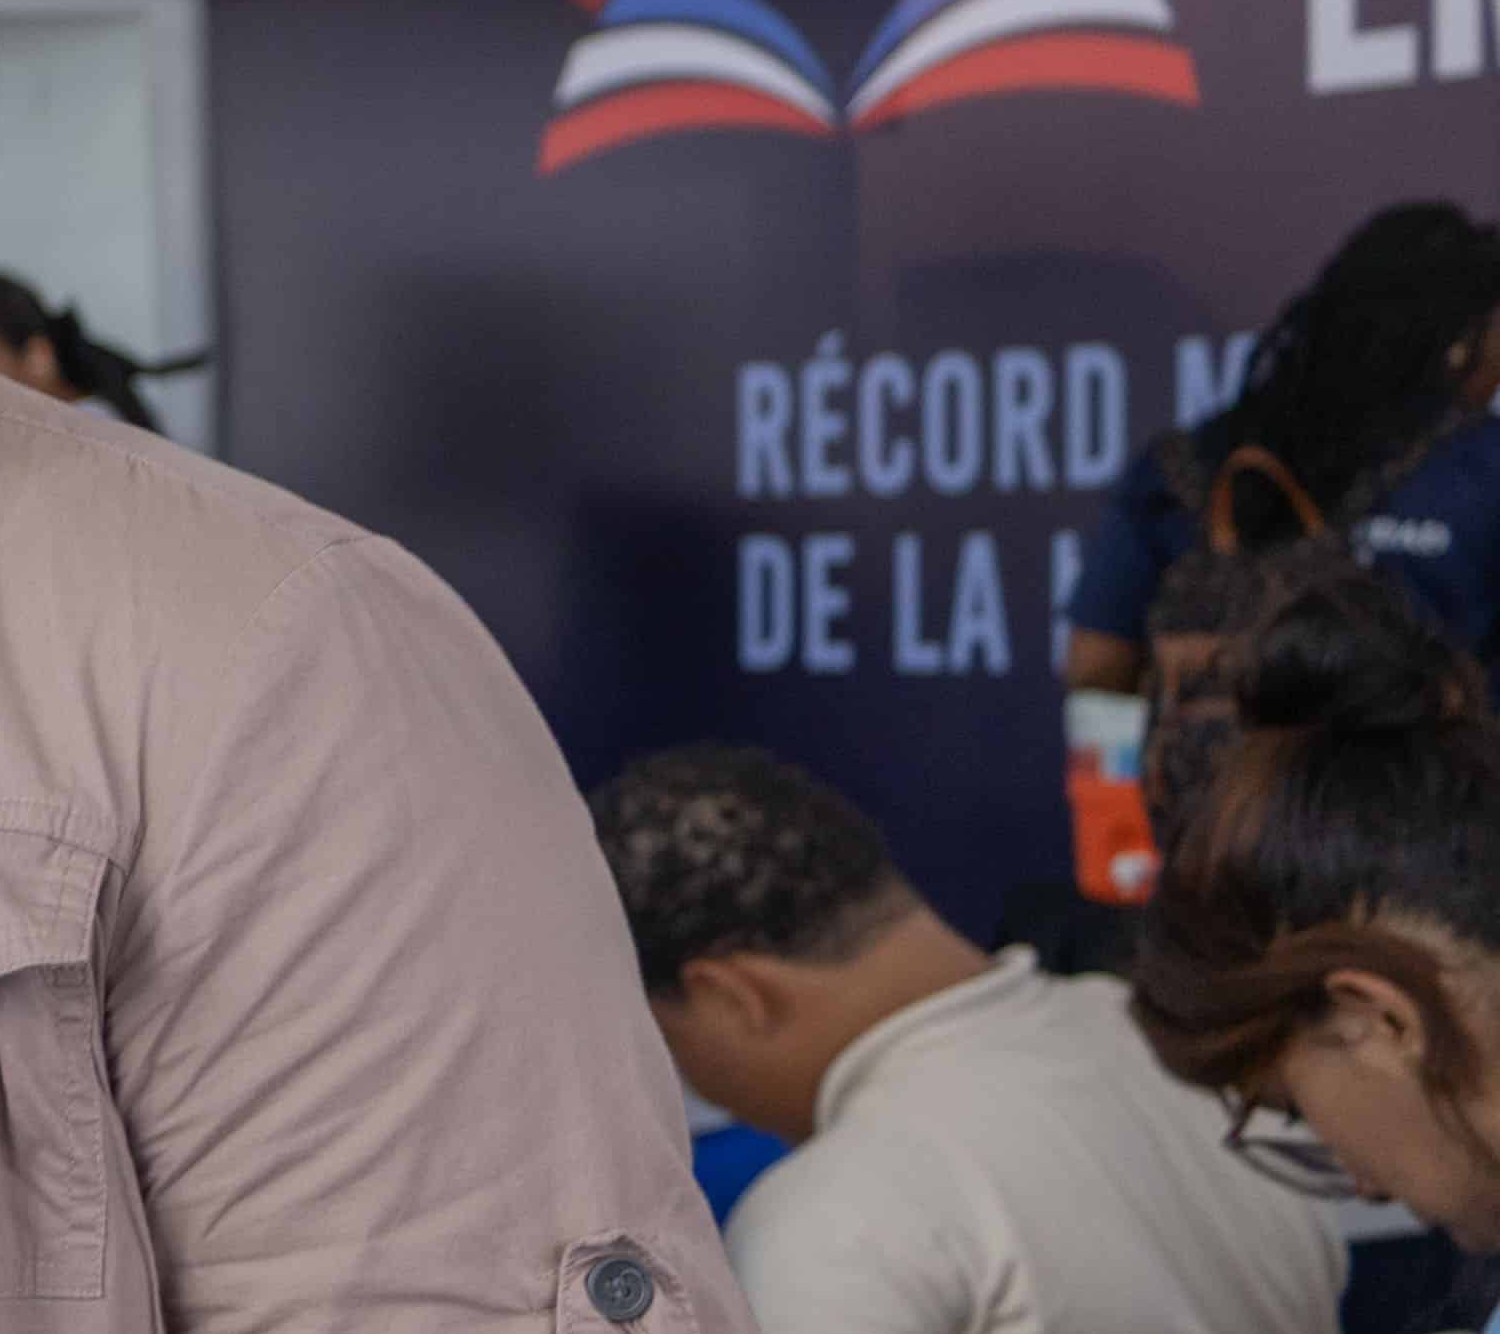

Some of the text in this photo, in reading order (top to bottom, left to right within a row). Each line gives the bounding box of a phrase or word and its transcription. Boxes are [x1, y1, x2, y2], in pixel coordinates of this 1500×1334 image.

[736, 329, 1130, 499] RÉCORD
[737, 532, 856, 673] DE
[893, 530, 1012, 674] LA
